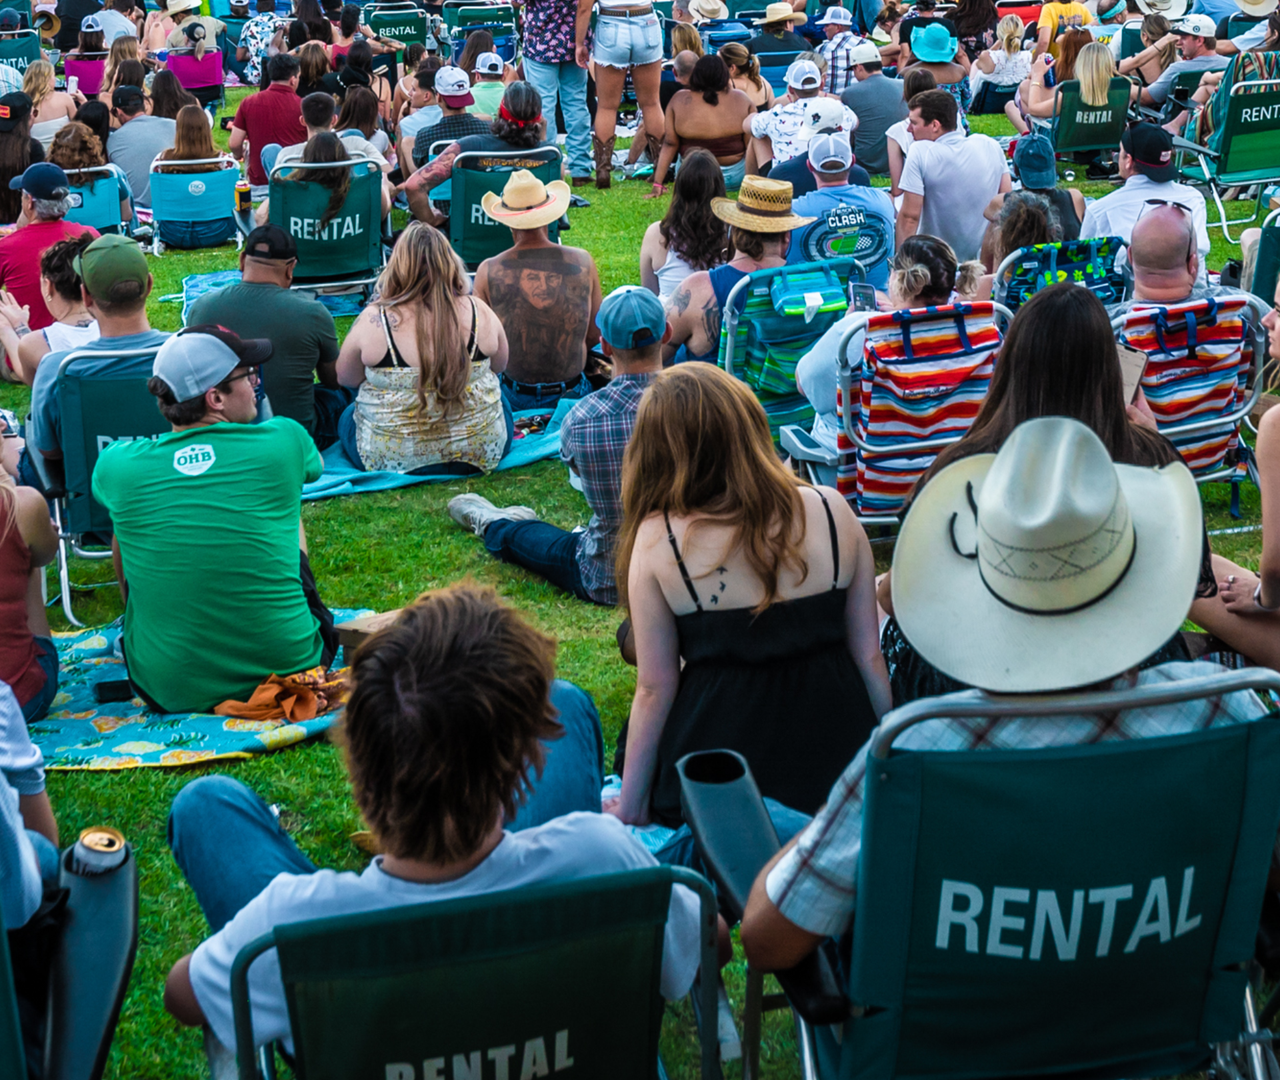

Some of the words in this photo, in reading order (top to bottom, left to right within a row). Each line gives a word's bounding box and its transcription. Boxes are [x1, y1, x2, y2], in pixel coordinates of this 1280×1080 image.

[379, 25, 417, 37] RENTAL
[1075, 110, 1113, 124] RENTAL
[289, 213, 364, 241] RENTAL
[828, 212, 866, 227] CLASH
[176, 450, 212, 467] OHB
[935, 866, 1202, 961] RENTAL
